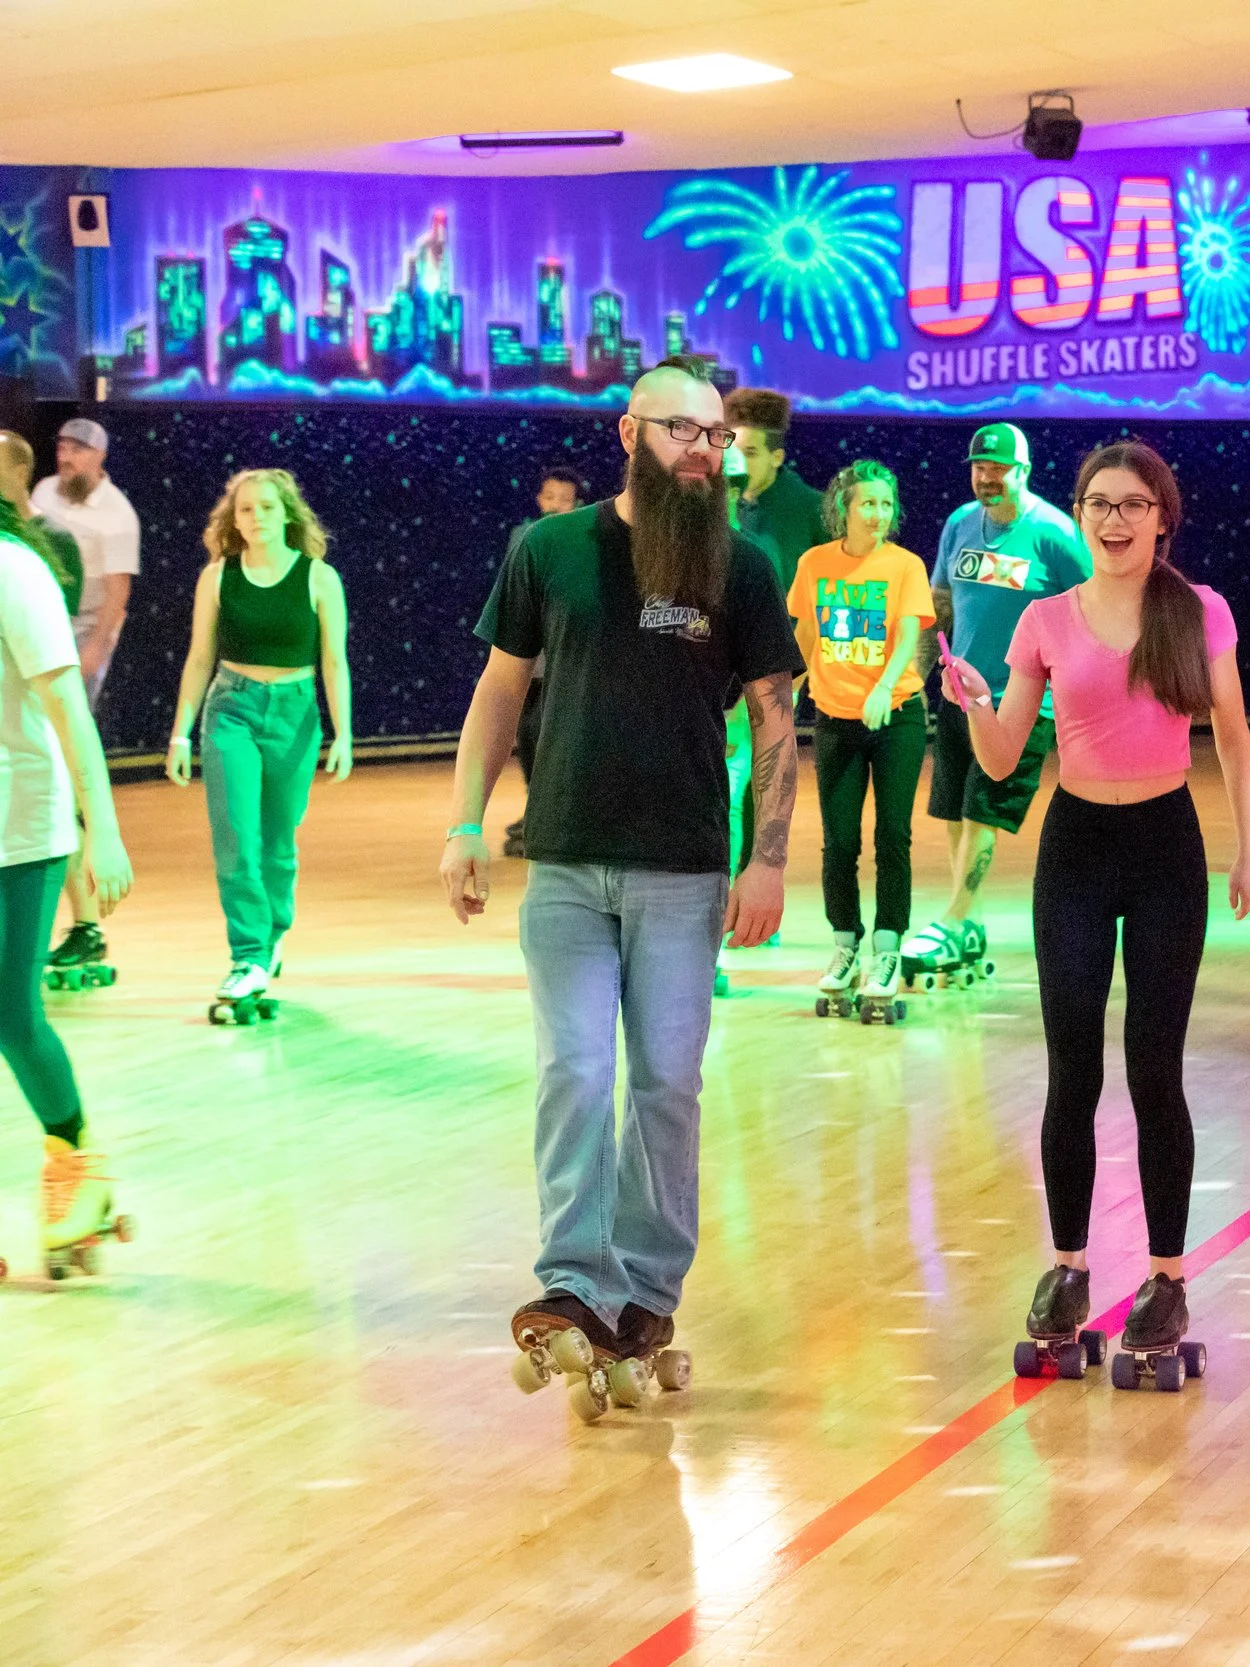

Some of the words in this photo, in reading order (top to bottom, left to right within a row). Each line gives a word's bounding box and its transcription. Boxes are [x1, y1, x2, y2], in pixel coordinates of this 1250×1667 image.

[908, 176, 1182, 337] USA
[906, 343, 1050, 391] SHUFFLE
[1058, 333, 1197, 377] SKATERS
[816, 577, 889, 611] LIVE
[639, 607, 701, 628] FREEMAN
